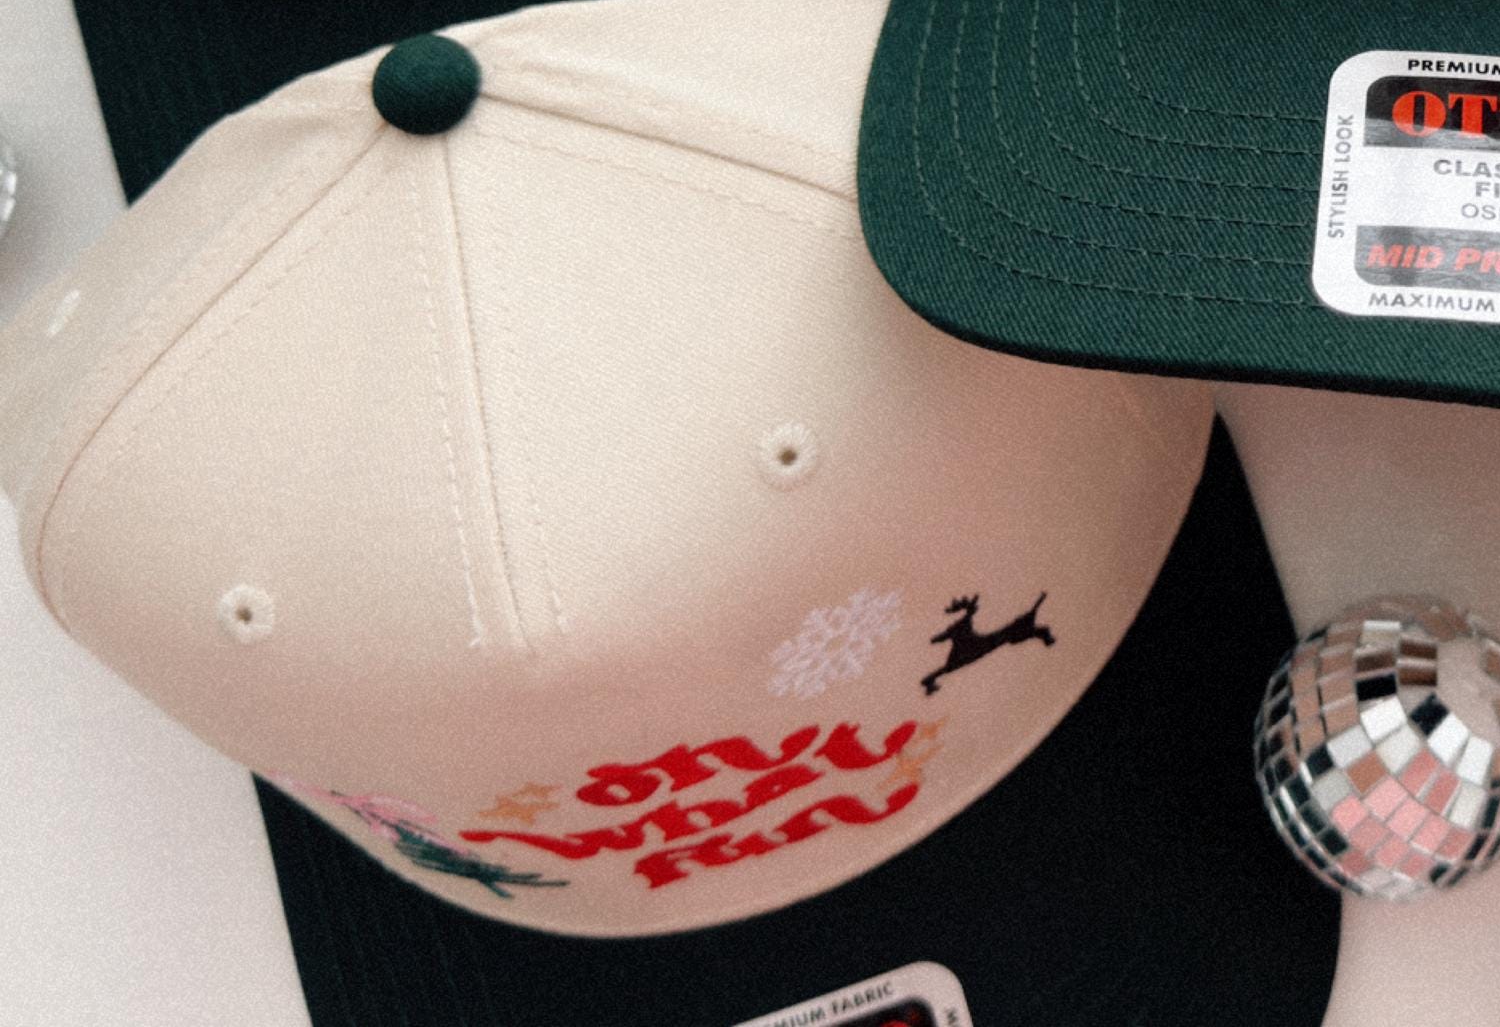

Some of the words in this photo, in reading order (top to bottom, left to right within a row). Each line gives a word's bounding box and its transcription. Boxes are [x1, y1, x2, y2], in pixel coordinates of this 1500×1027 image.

[1337, 114, 1355, 164] LOOK
[1327, 170, 1350, 239] STYLISH
[1366, 244, 1446, 269] MID
[1368, 292, 1496, 313] MAXIMUM
[458, 720, 919, 861] what
[831, 982, 895, 1015] FABRIC
